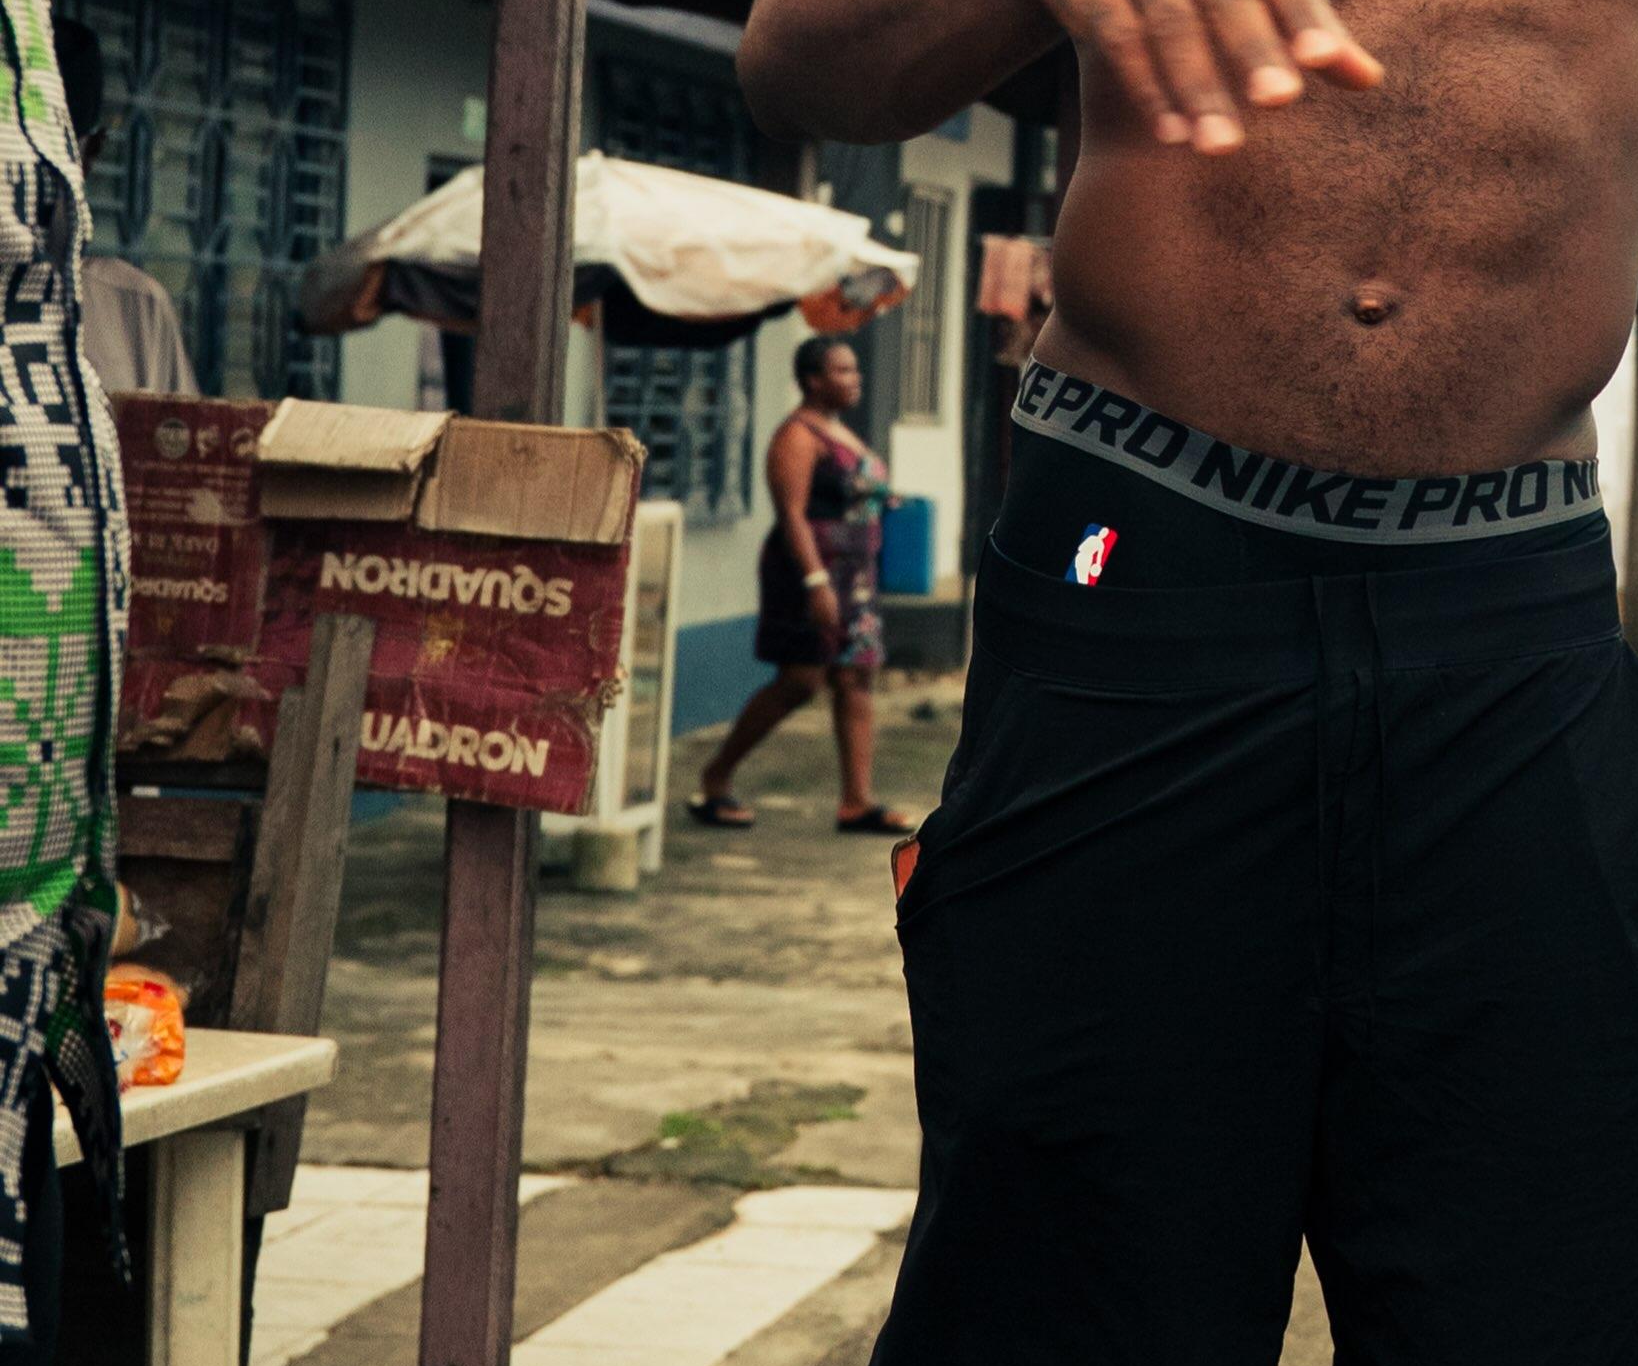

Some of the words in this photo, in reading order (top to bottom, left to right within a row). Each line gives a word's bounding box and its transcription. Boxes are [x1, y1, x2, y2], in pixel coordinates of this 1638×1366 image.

[1041, 376, 1190, 469] PRO
[1190, 440, 1400, 530] NIKE
[1397, 460, 1549, 530] PRO
[1563, 460, 1600, 506] NI
[320, 551, 574, 617] SQUADRON
[360, 712, 549, 777] UADRON
